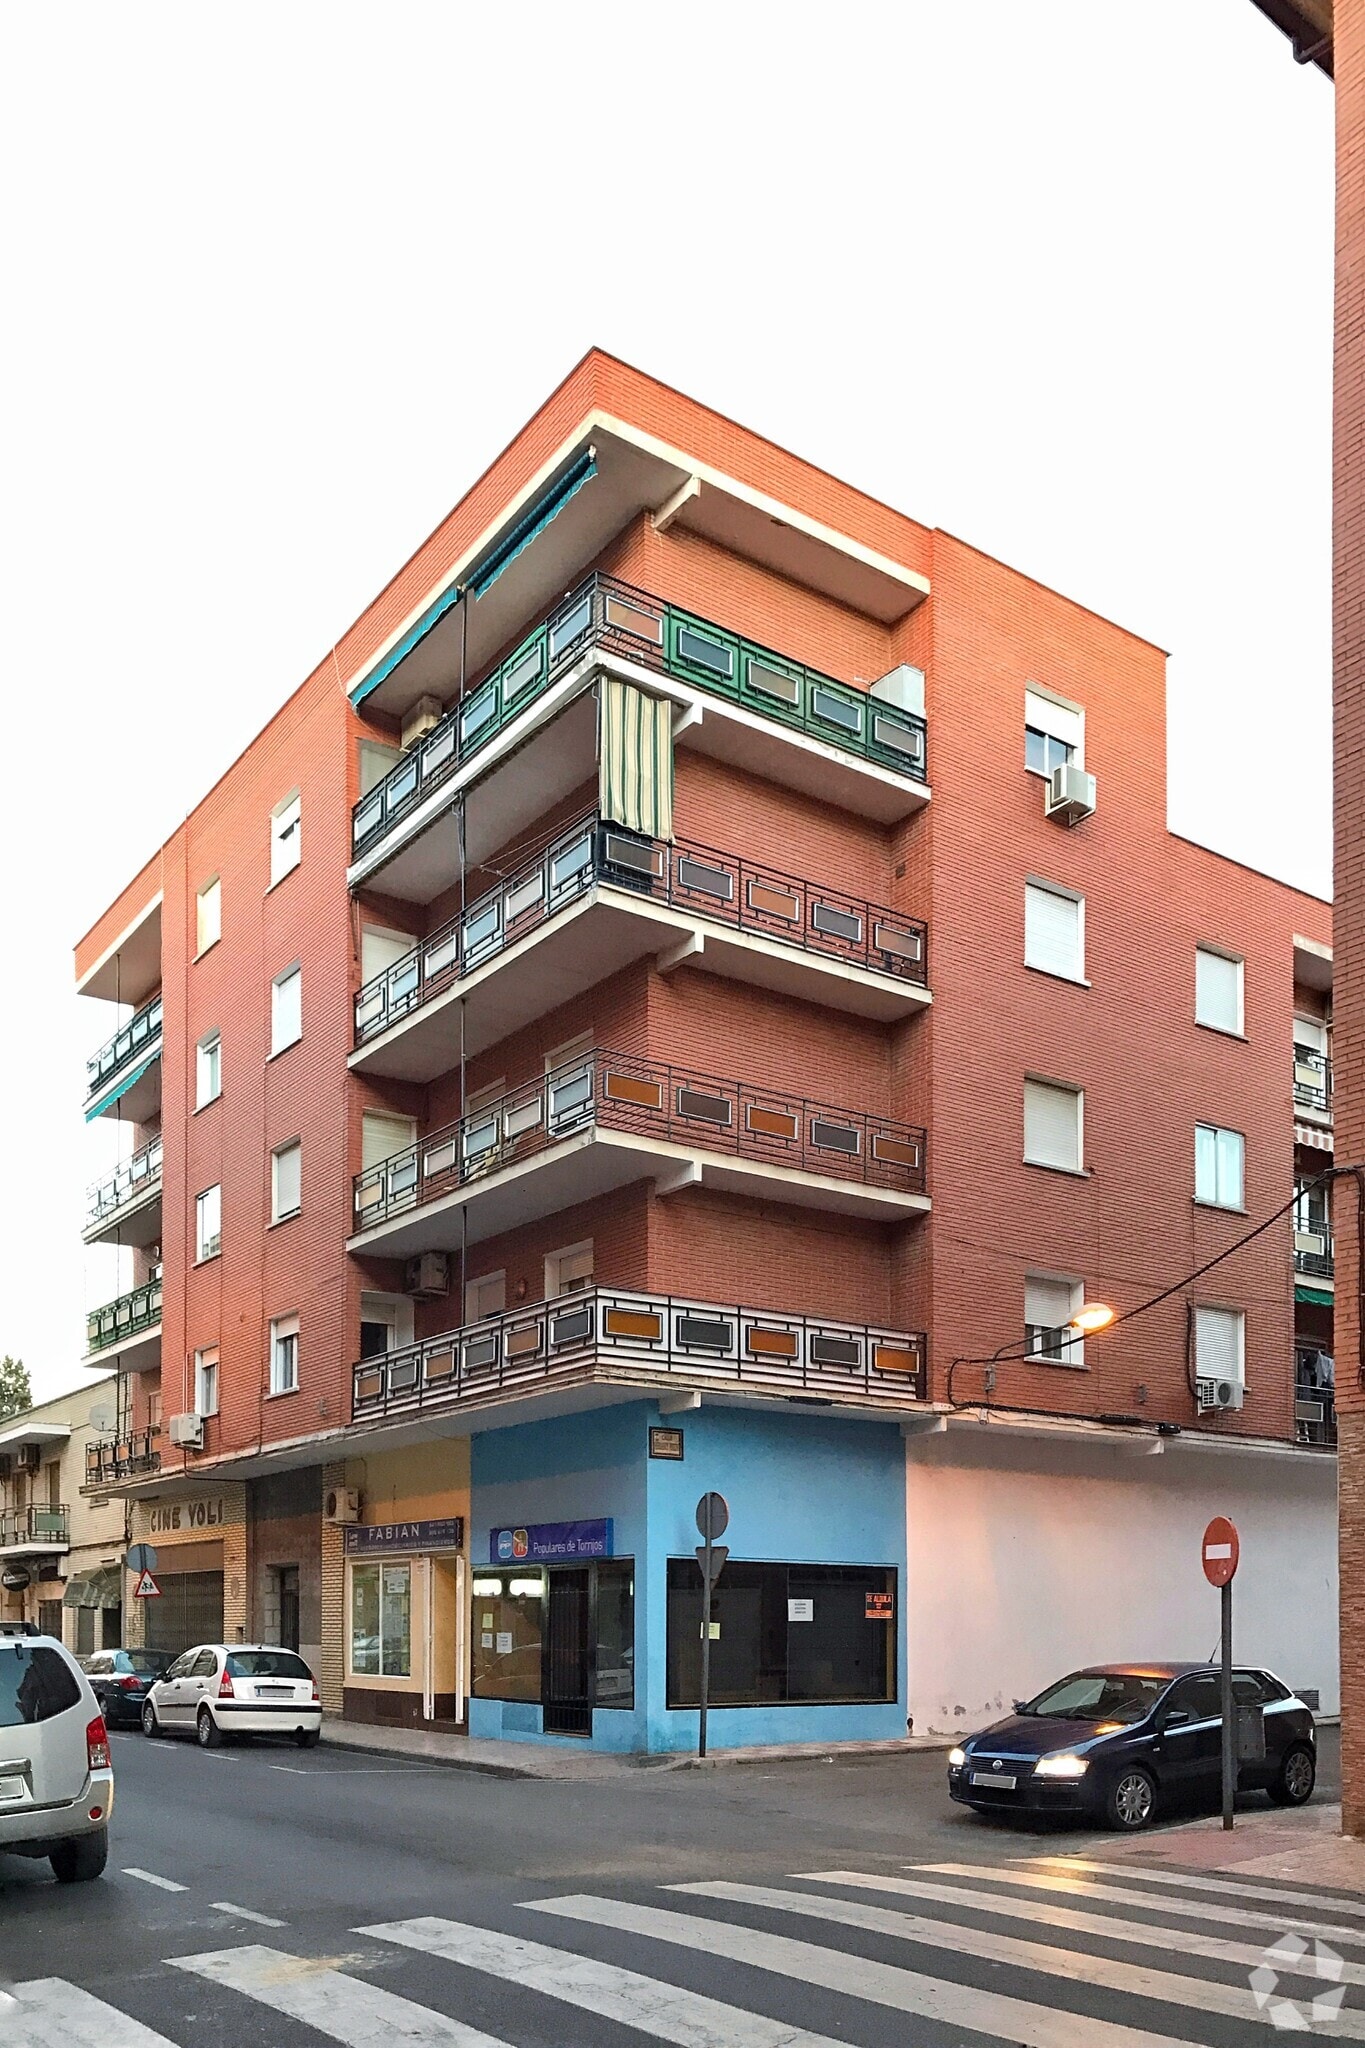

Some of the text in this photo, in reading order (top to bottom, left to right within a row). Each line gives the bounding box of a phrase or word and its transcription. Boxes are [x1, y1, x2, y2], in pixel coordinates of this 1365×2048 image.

[150, 1499, 223, 1532] CINE YOLI
[368, 1524, 420, 1540] FABIAN
[533, 1538, 603, 1555] Populares de Torrijos
